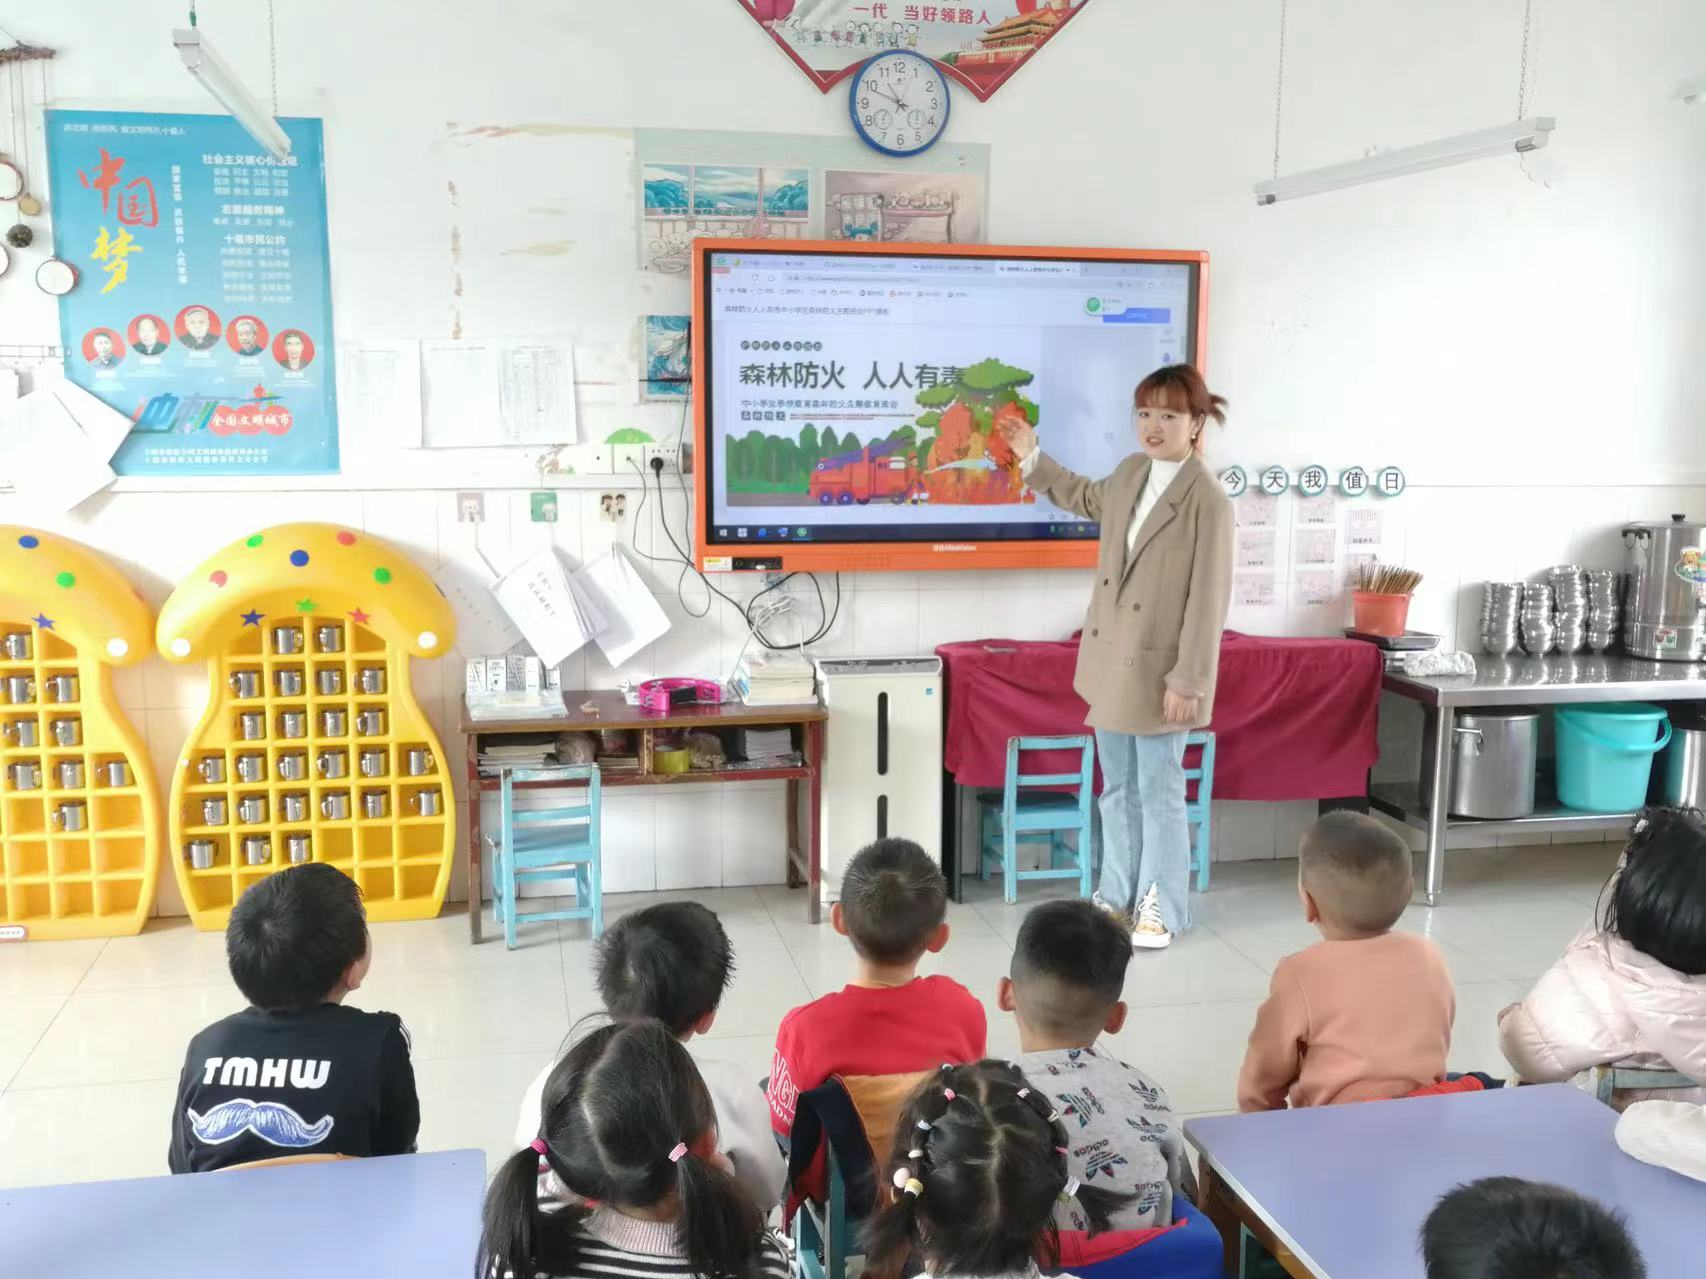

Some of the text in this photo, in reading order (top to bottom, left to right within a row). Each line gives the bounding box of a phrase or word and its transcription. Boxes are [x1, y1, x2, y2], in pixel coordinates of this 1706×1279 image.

[854, 3, 991, 25] 一代 当好领路人
[879, 67, 889, 78] 11
[893, 62, 906, 74] 12
[912, 67, 919, 78] 1
[865, 80, 878, 92] 10
[925, 81, 934, 93] 2
[860, 98, 869, 110] 9
[930, 98, 938, 110] 3
[865, 115, 873, 127] 8
[927, 116, 935, 126] 4
[880, 131, 887, 142] 7
[896, 134, 904, 146] 6
[914, 131, 921, 142] 5
[739, 360, 965, 390] 森林防火 人人有责
[1223, 470, 1400, 491] 今天我值日
[202, 1056, 331, 1089] TMHW
